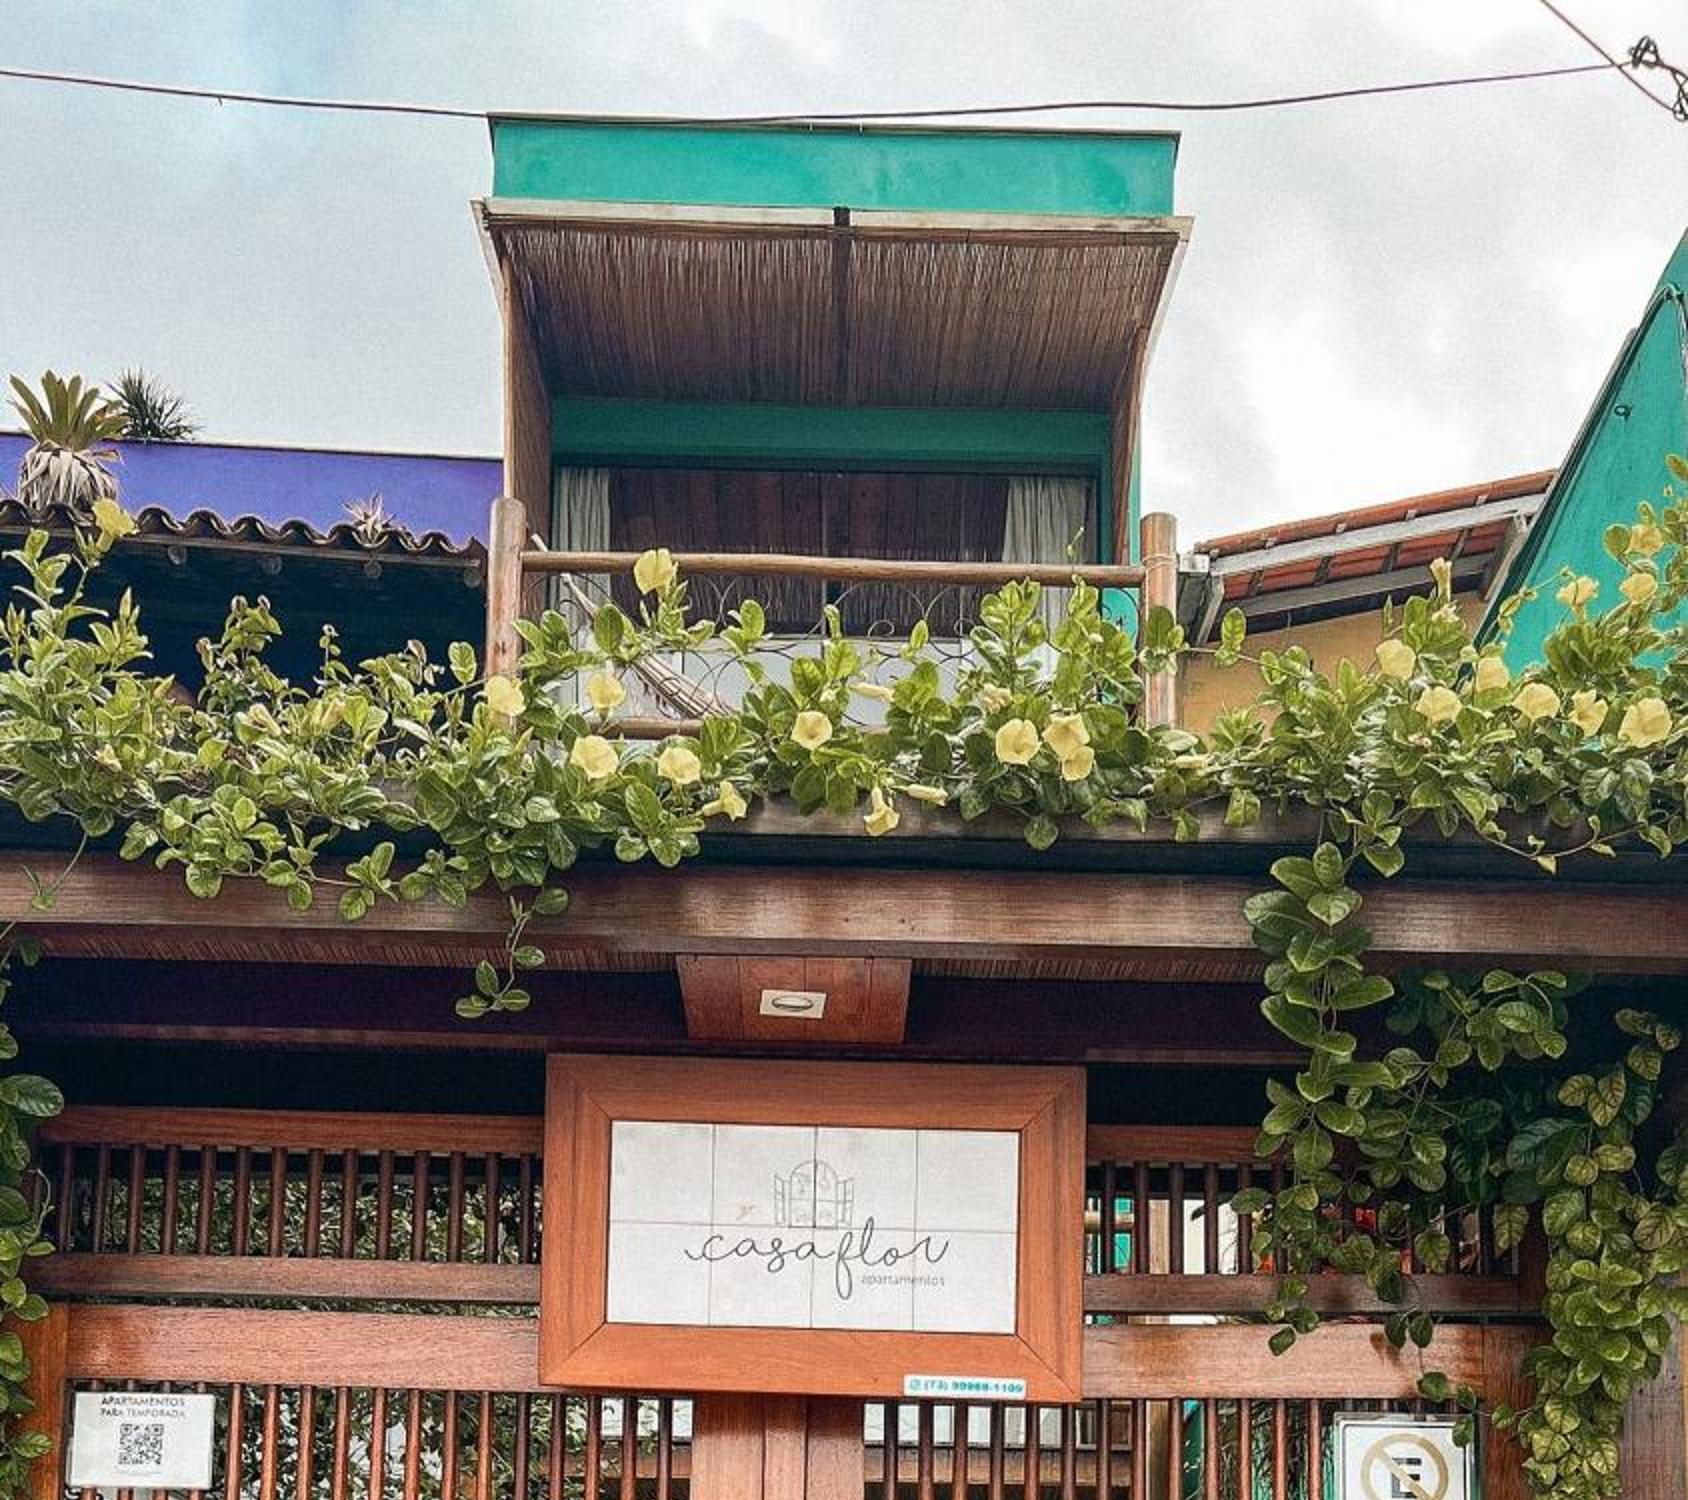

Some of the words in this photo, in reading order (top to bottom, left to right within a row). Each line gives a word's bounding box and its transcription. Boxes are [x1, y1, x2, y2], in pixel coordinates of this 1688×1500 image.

[861, 1274, 945, 1288] apartamentos
[101, 1396, 185, 1407] APARTAMENTOS
[100, 1407, 124, 1417] PARA
[126, 1408, 186, 1418] TEMPORADA
[1391, 1457, 1422, 1499] E
